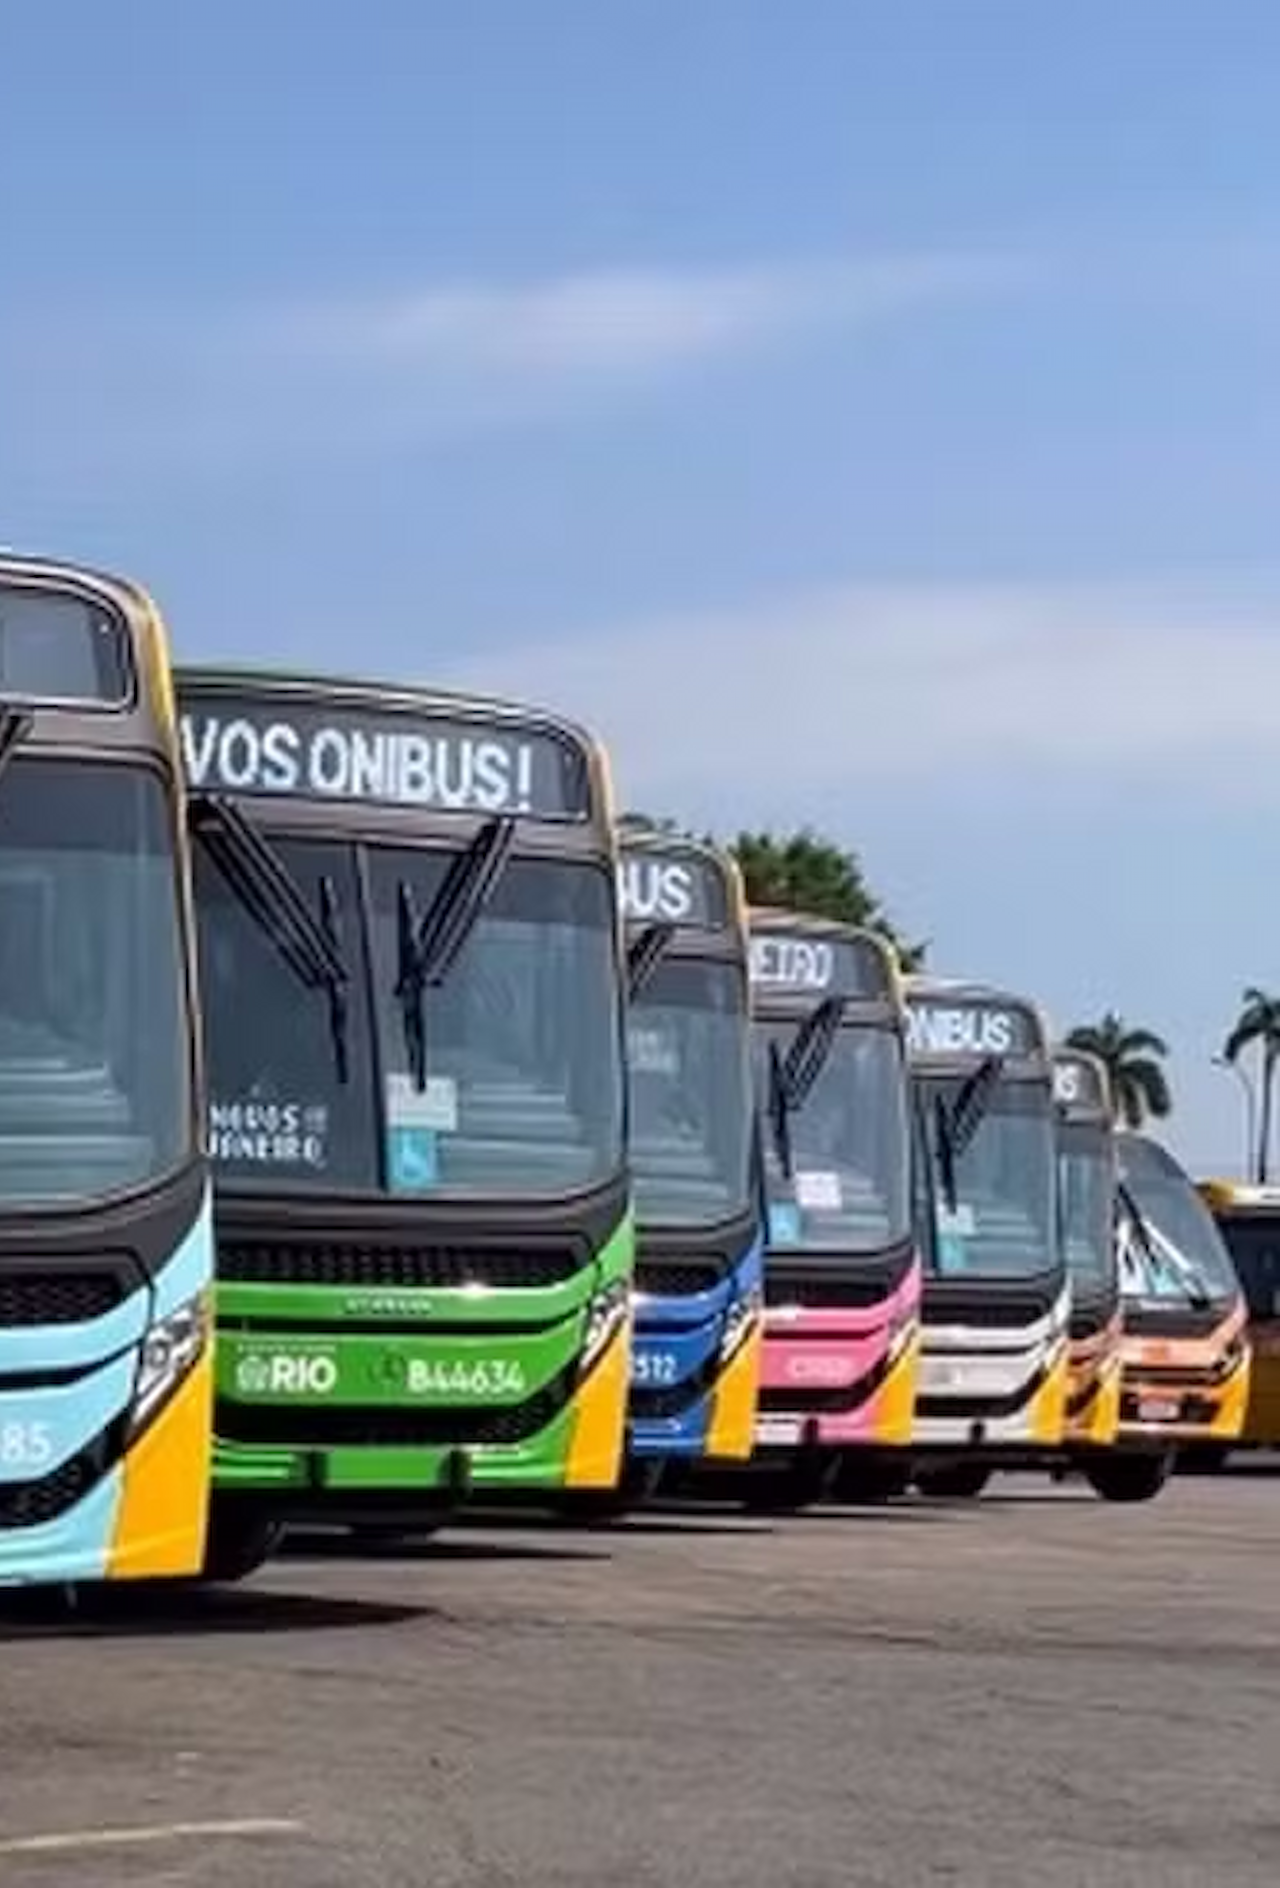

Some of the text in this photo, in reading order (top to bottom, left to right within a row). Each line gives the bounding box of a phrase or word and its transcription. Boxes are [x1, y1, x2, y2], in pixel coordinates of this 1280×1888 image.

[181, 714, 532, 812] VOS ONIBUS!
[271, 1355, 337, 1394] RIO
